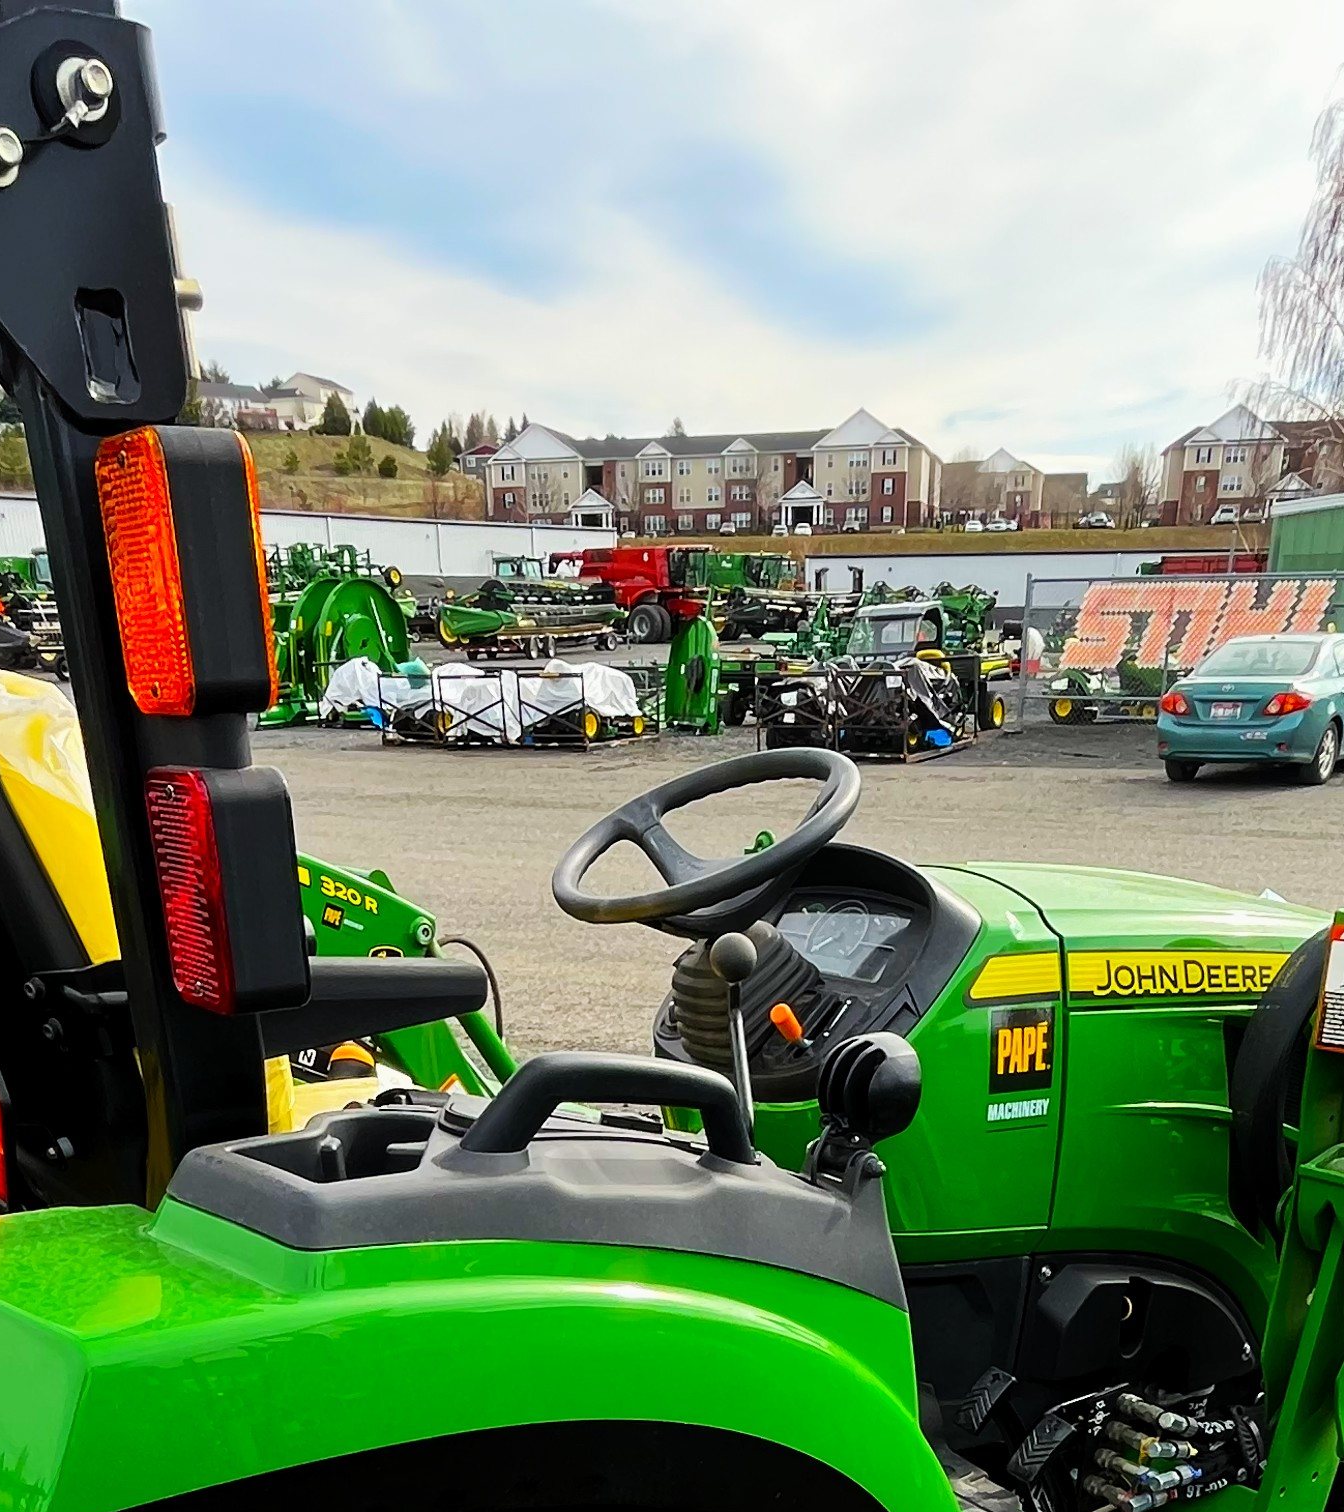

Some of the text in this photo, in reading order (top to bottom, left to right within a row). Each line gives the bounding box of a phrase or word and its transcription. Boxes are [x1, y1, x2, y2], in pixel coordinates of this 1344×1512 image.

[320, 875, 378, 915] 320 R
[1095, 958, 1274, 992] JOHN DEERE
[986, 1098, 1050, 1122] MACHINERY
